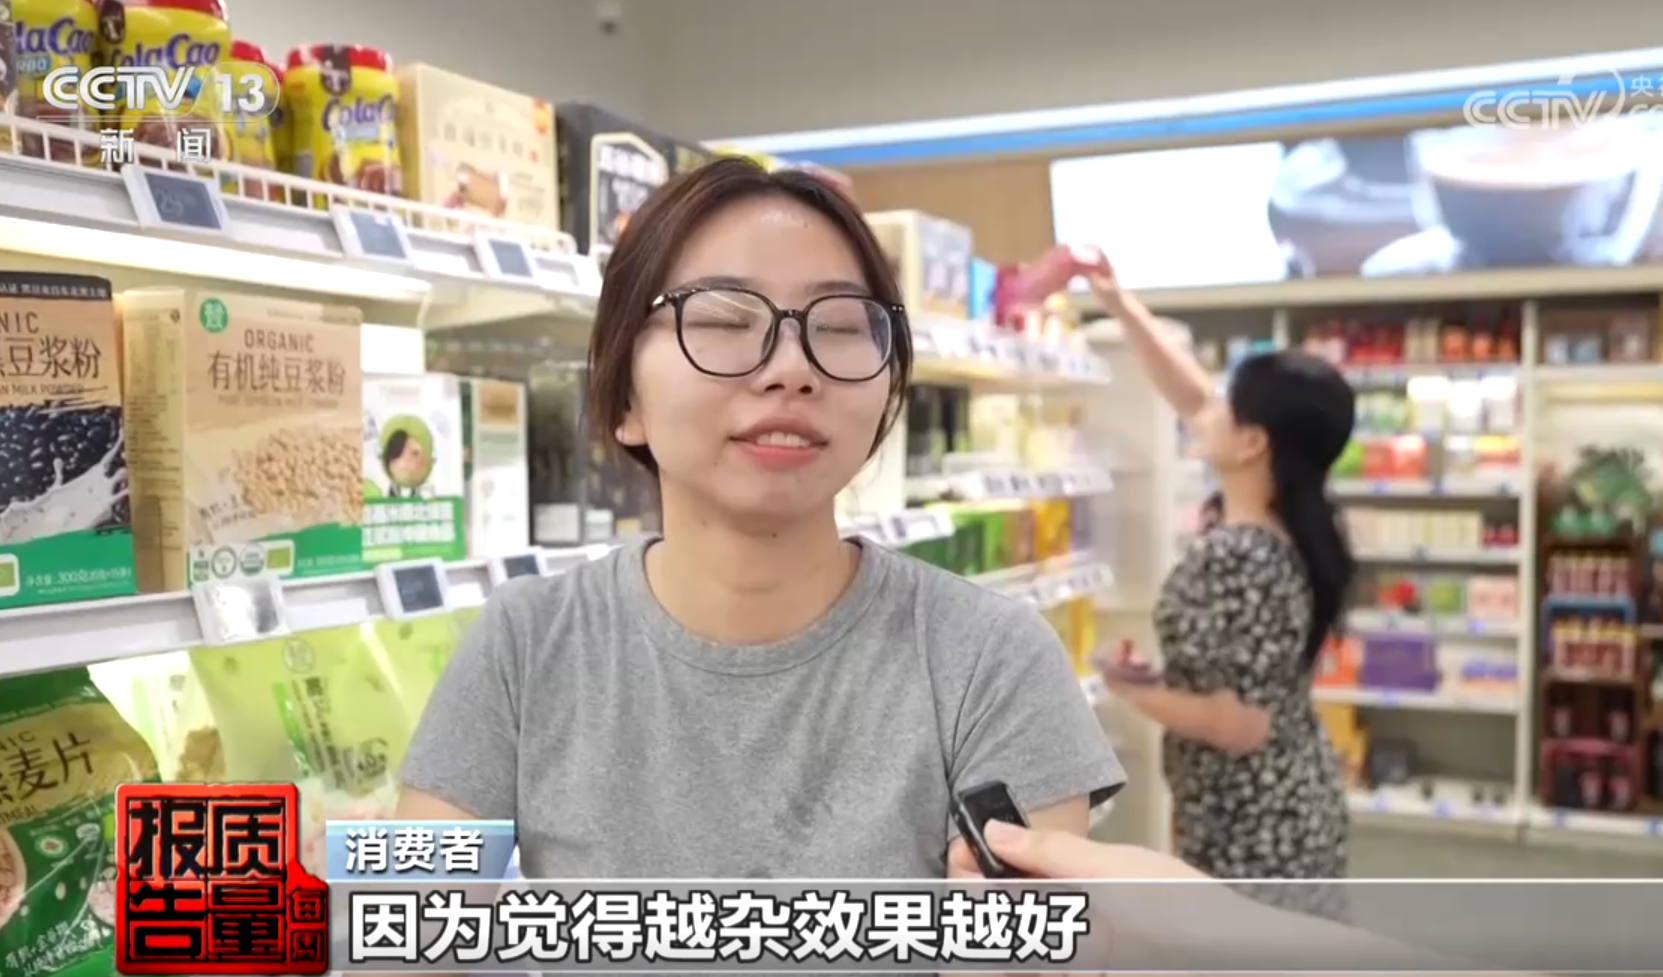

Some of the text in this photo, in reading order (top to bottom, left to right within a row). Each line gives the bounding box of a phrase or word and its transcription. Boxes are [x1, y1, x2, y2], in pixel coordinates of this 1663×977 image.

[0, 335, 101, 379] 豆浆粉
[244, 328, 315, 352] ORGANIC
[207, 350, 346, 395] 有机纯豆浆粉
[0, 731, 93, 804] 麦片
